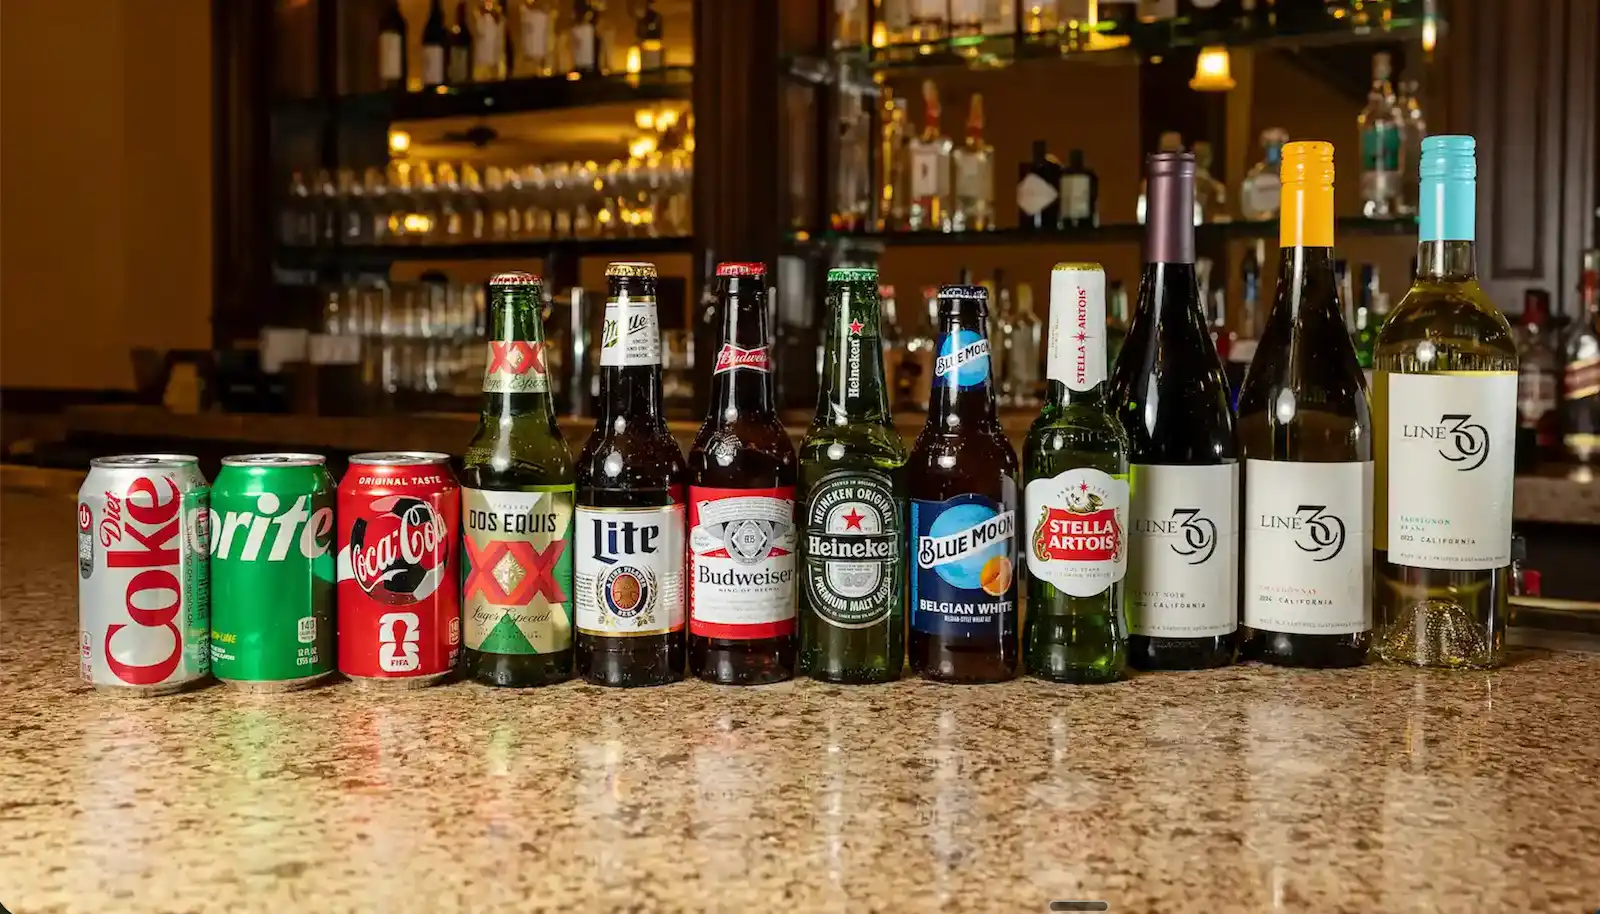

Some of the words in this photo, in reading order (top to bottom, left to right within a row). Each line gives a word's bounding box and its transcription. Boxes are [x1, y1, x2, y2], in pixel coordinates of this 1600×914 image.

[1078, 289, 1087, 329] ARTOIS
[848, 338, 860, 398] Heineken
[1077, 346, 1086, 384] STELLA
[1403, 425, 1446, 439] LINE
[1438, 414, 1490, 471] 39
[359, 477, 408, 486] ORIGINAL
[412, 476, 442, 485] TASTE
[100, 491, 121, 547] Diet
[469, 509, 498, 532] DOS
[504, 513, 557, 534] EQUIS
[814, 488, 854, 524] HEINEKEN
[856, 488, 893, 525] ORIGINAL
[591, 518, 660, 565] Lite
[919, 539, 968, 565] BLUE
[972, 515, 1013, 548] MOON
[1048, 535, 1114, 551] ARTOIS
[1049, 519, 1114, 535] STELLA
[1136, 519, 1178, 533] LINE
[1170, 508, 1217, 565] 39
[1261, 515, 1303, 529] LINE
[1294, 505, 1346, 562] 39
[1420, 537, 1476, 545] CALIFORNIA
[352, 500, 448, 592] Coca-Cola
[808, 535, 899, 558] Heineken
[104, 475, 182, 685] Coke
[463, 534, 568, 606] XX
[698, 565, 794, 586] Budweiser
[814, 575, 848, 611] PREMIUM
[849, 598, 874, 612] MALT
[872, 576, 893, 605] LAGER
[920, 598, 974, 615] BELGIAN
[977, 601, 1013, 615] WHITE
[1278, 598, 1334, 606] CALIFORNIA
[471, 604, 499, 627] Lager
[501, 607, 552, 629] Especial
[391, 659, 409, 667] FIFA
